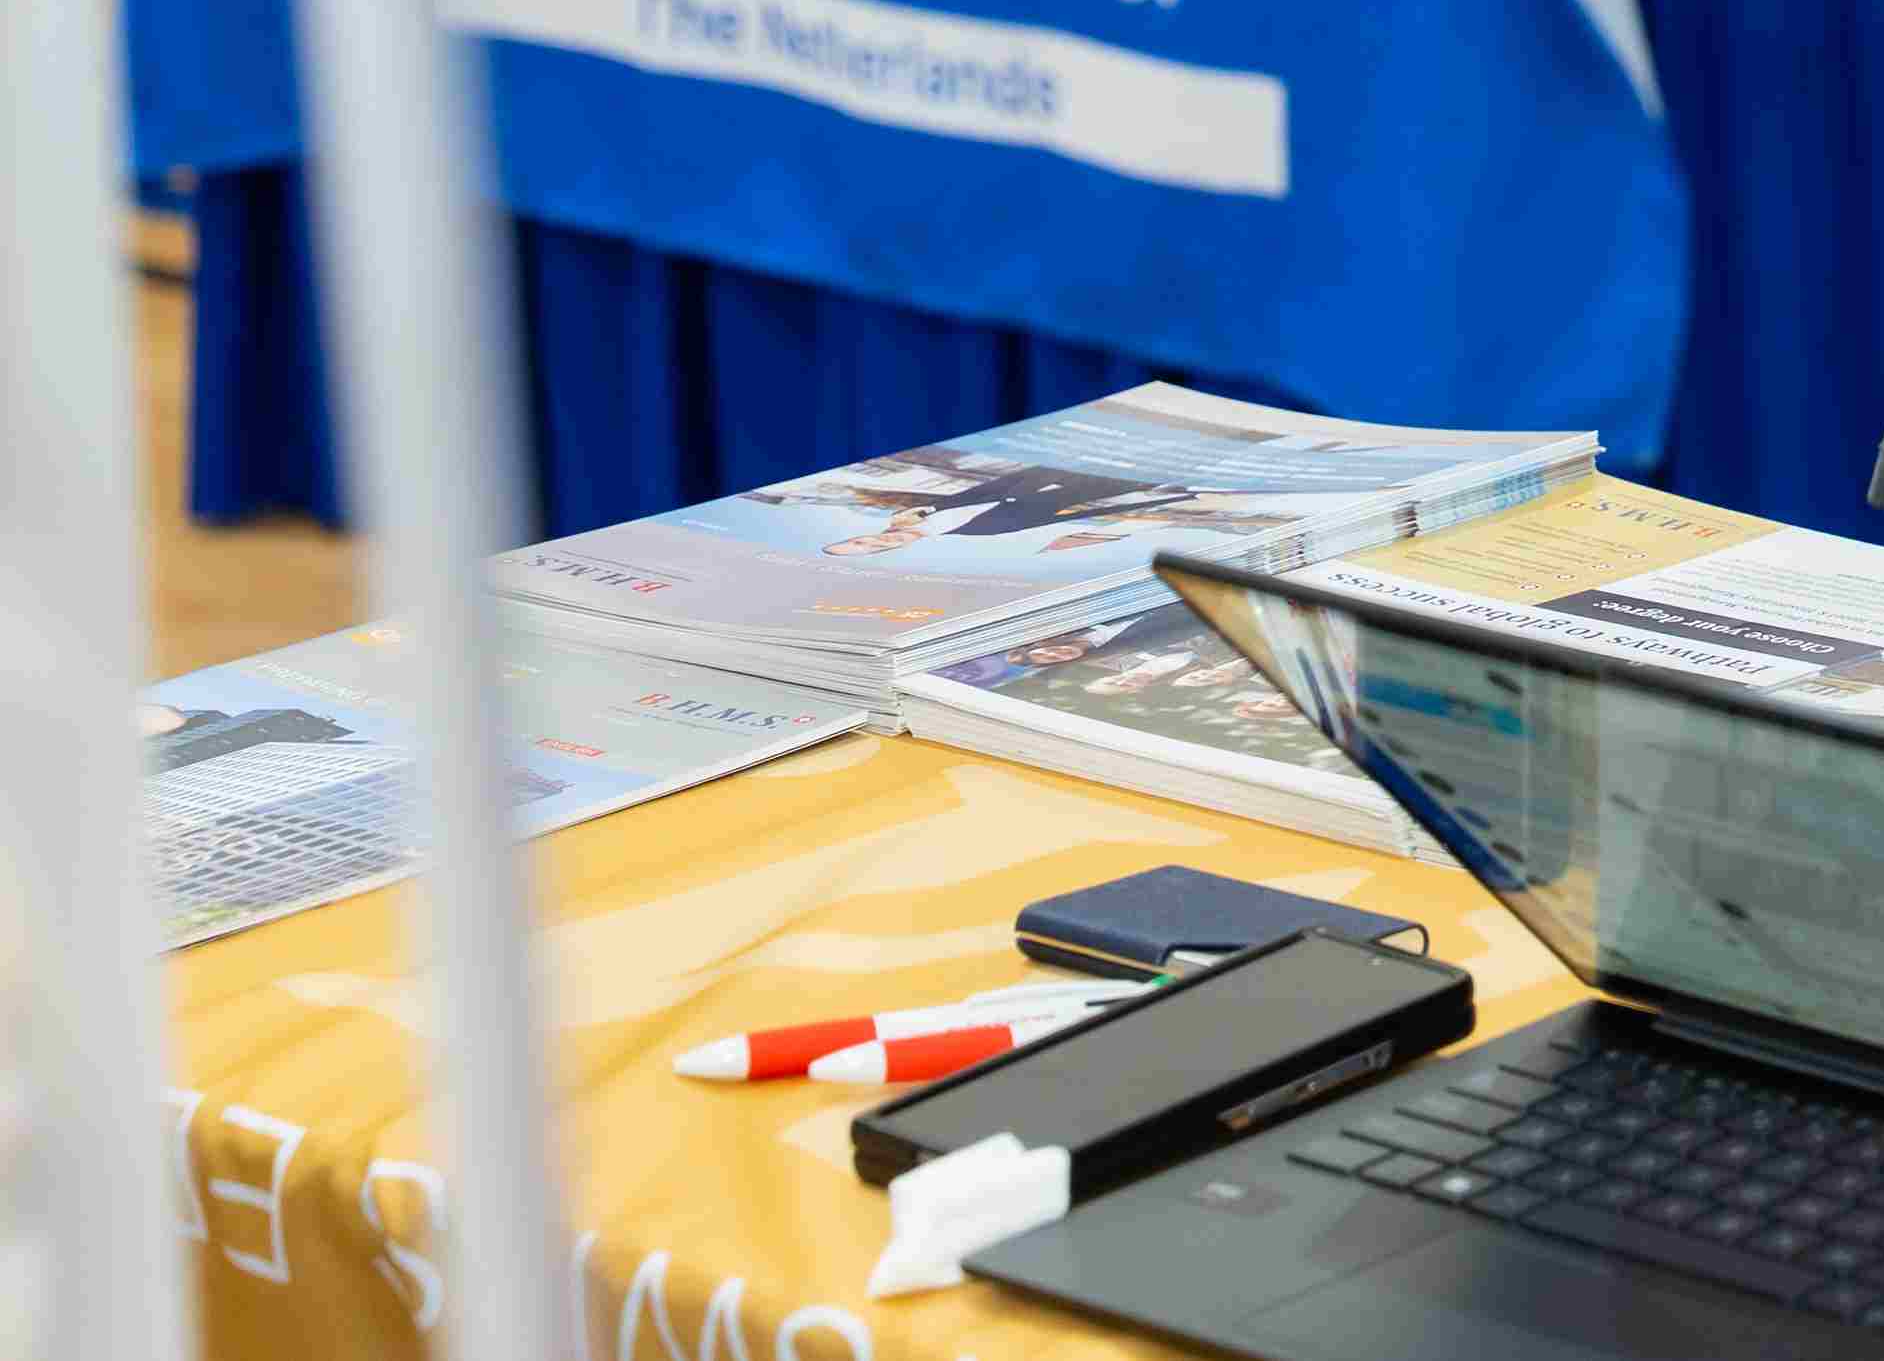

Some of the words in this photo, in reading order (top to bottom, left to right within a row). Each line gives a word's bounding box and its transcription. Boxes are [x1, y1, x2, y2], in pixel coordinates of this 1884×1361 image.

[758, 0, 1062, 120] Netherlands
[1327, 570, 1457, 611] success
[1459, 601, 1566, 637] global
[1565, 623, 1605, 642] to
[1681, 615, 1744, 640] your
[1610, 631, 1772, 678] Pathways
[1744, 628, 1837, 656] Choose
